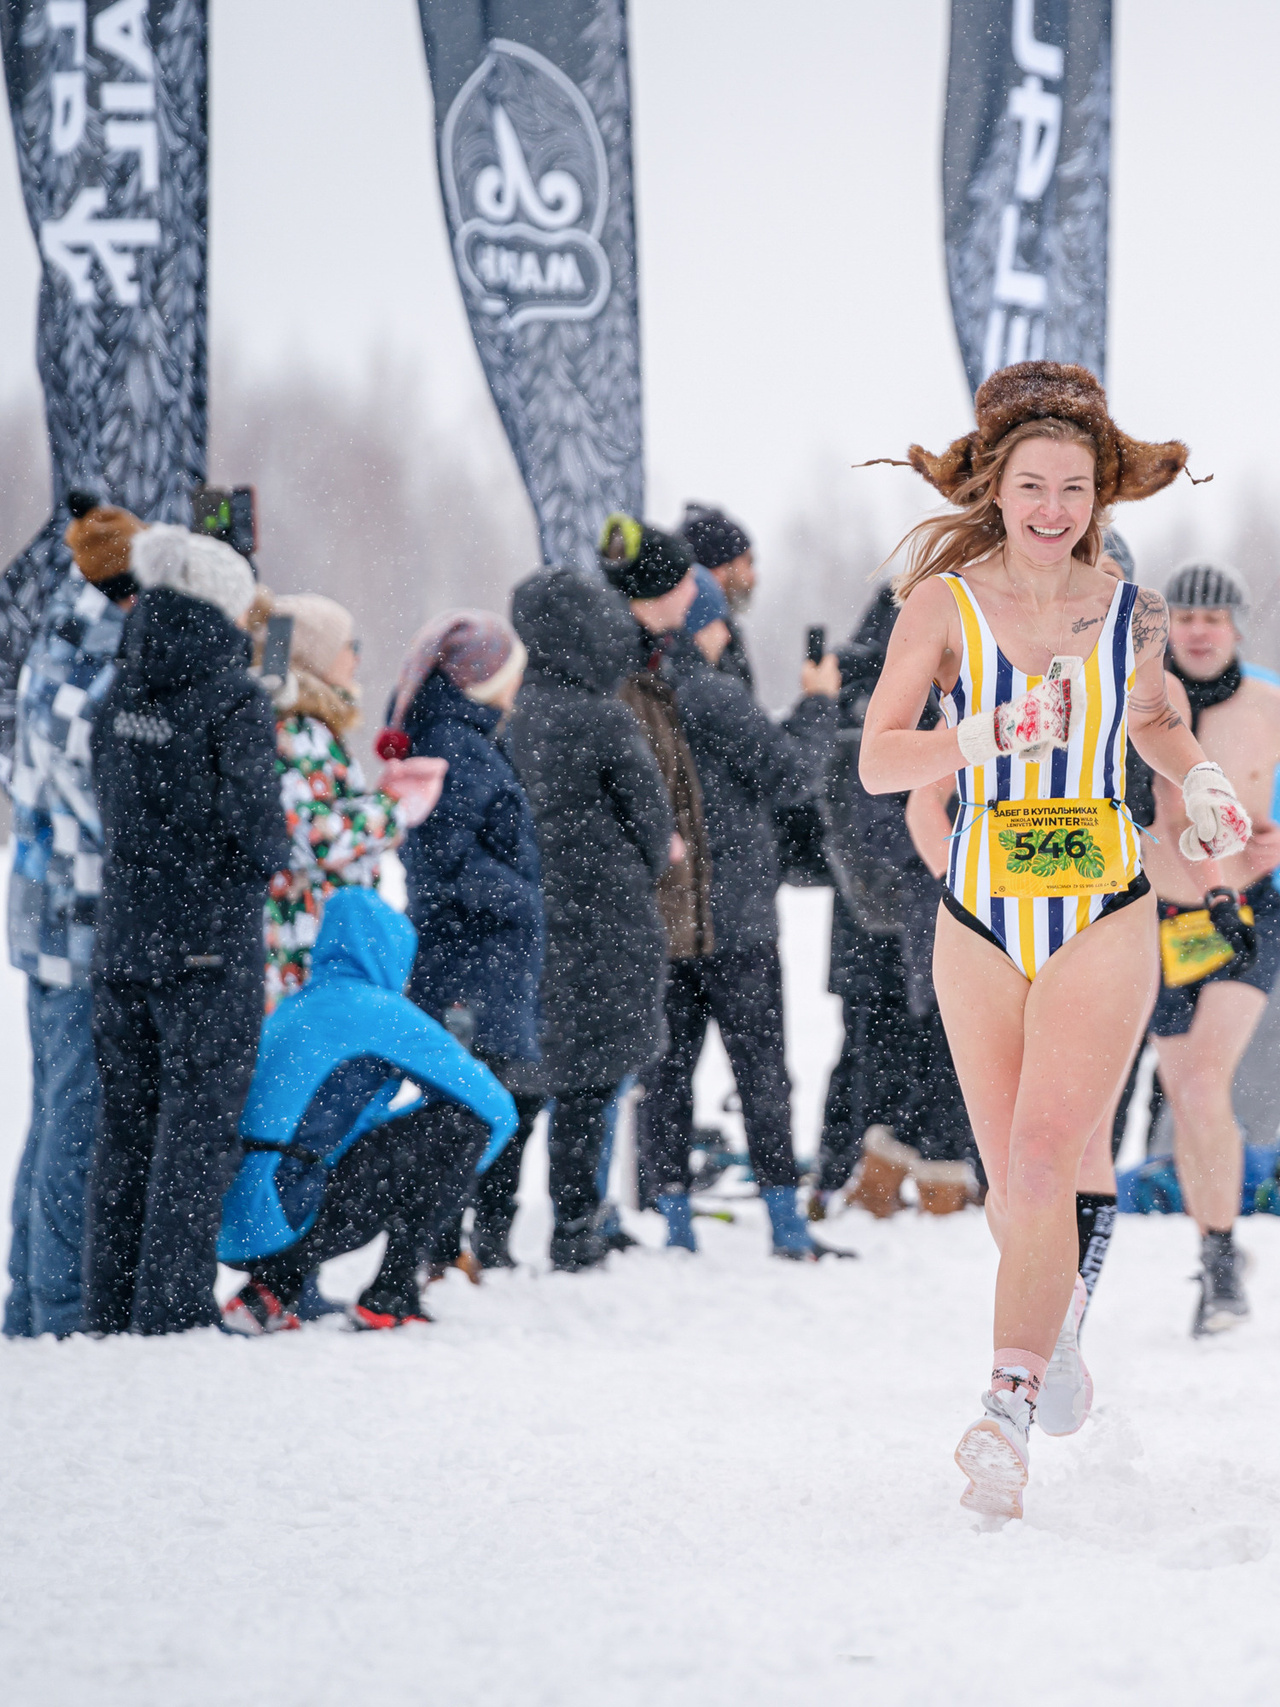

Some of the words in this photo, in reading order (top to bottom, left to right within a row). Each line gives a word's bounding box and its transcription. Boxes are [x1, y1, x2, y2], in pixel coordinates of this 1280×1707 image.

[994, 808, 1022, 817] ЗАБЕГ
[1023, 808, 1030, 816] В
[1031, 807, 1098, 815] КУПАЛЬНИКАХ
[1032, 817, 1080, 827] WINTER
[1014, 829, 1086, 861] 546
